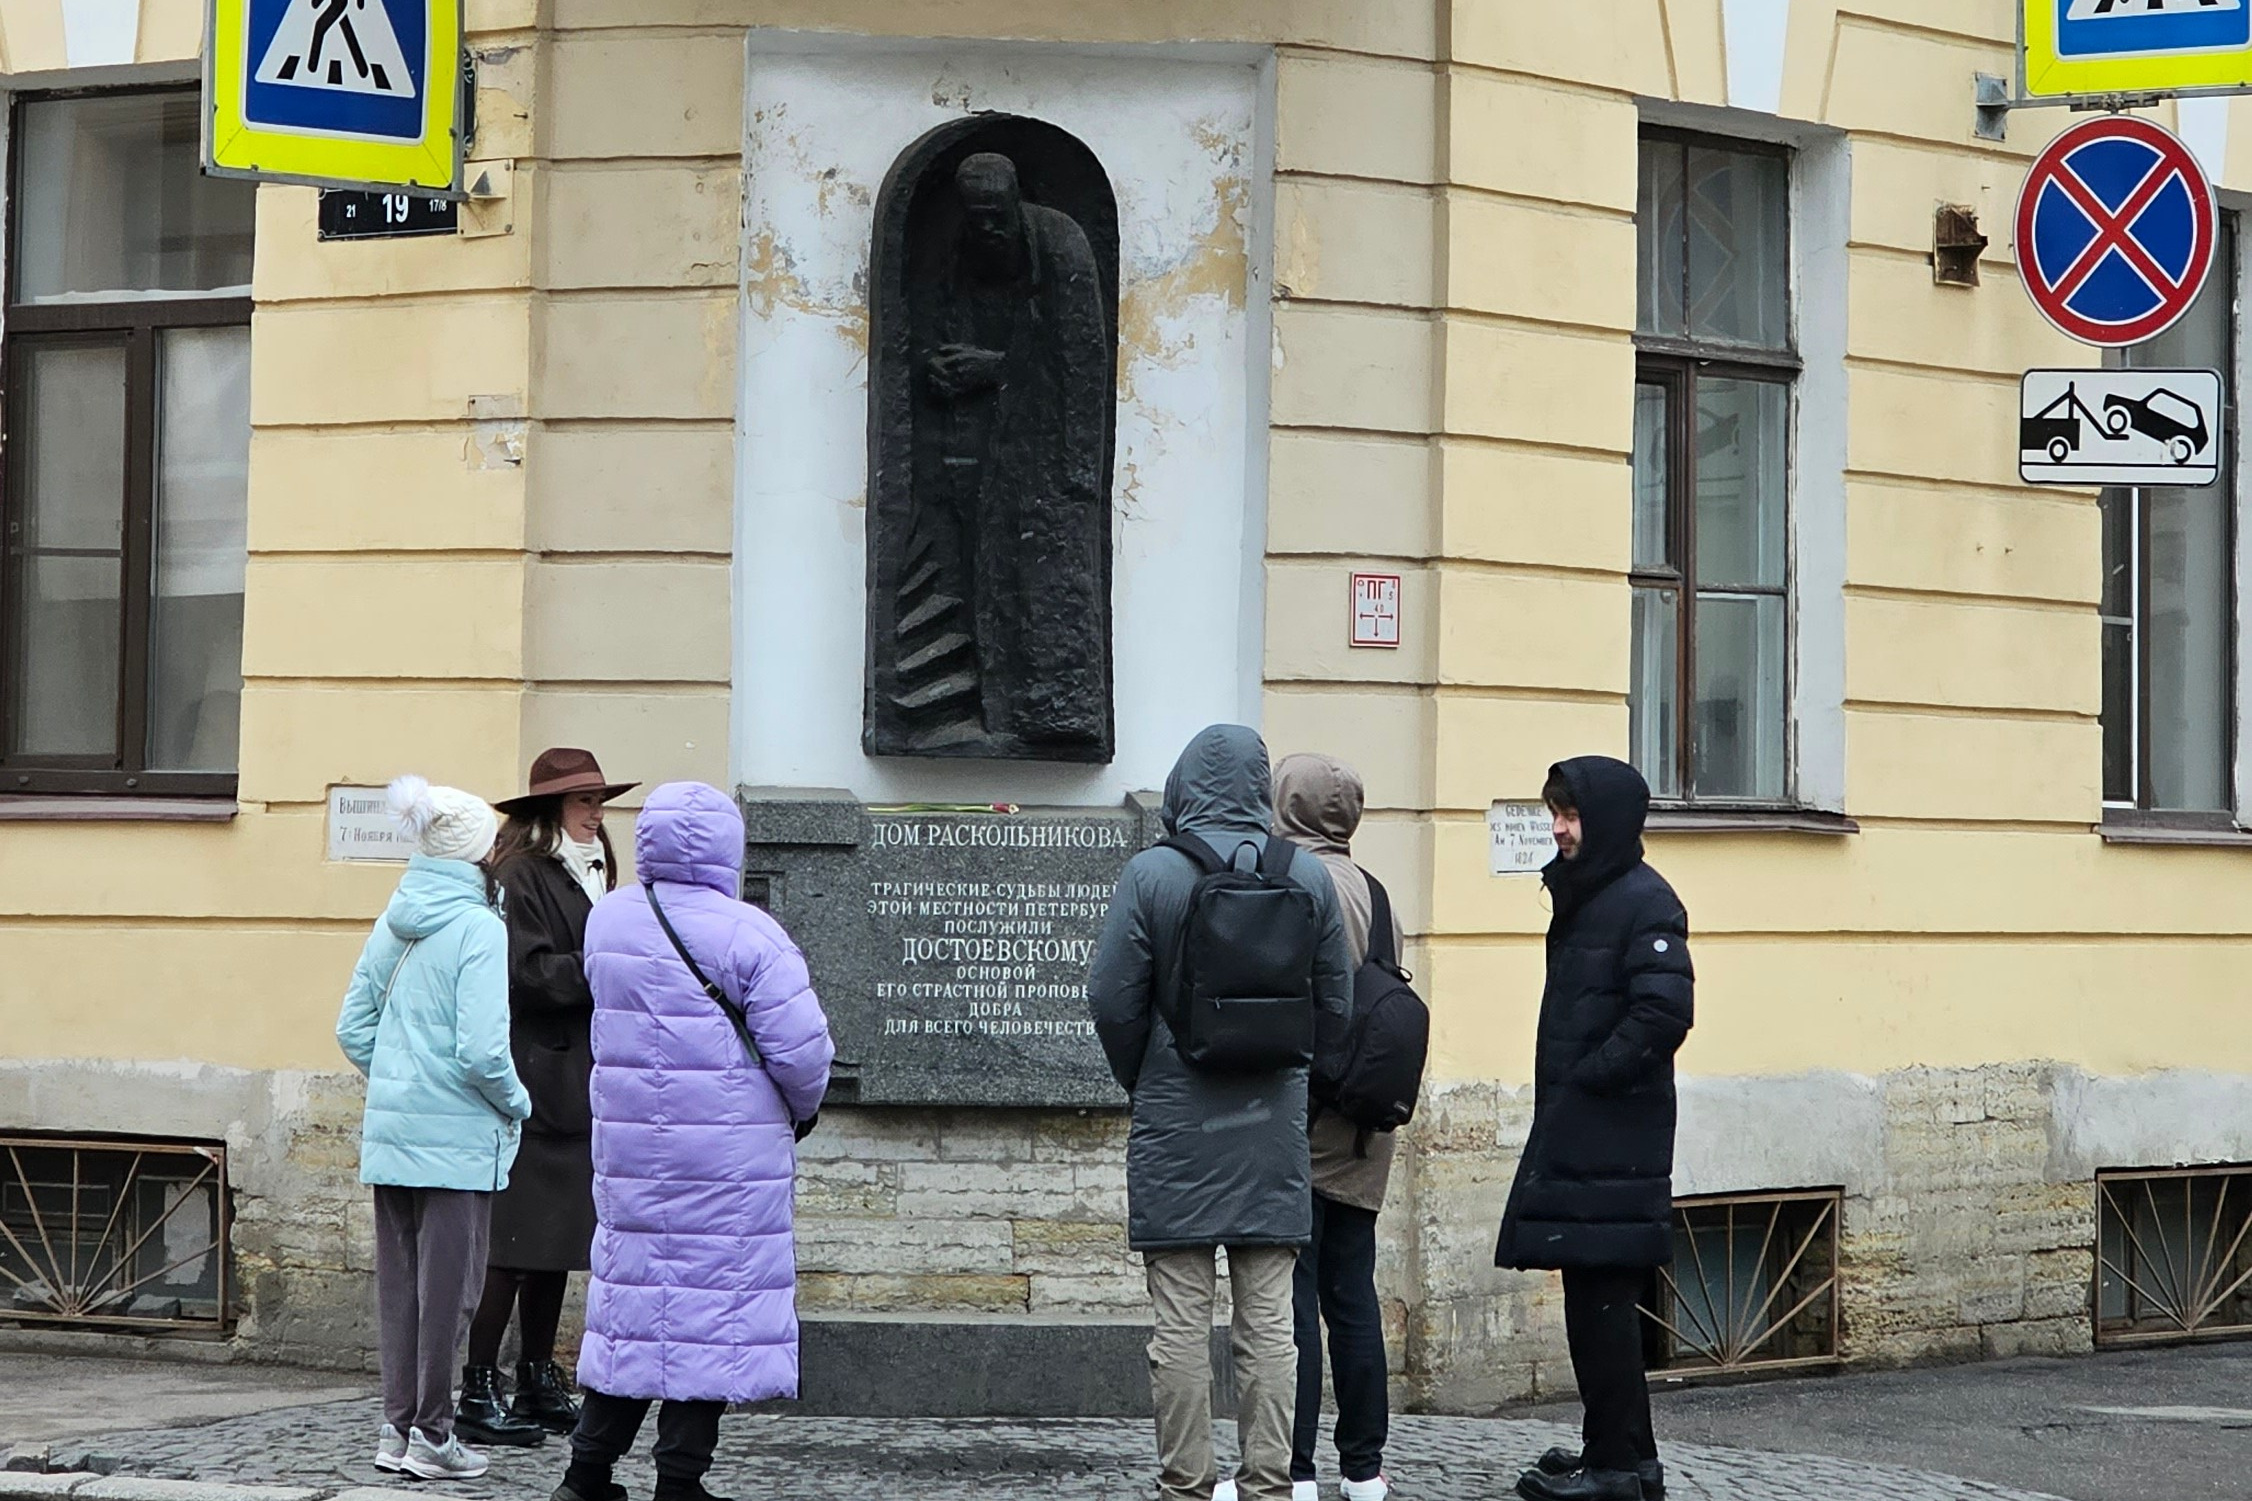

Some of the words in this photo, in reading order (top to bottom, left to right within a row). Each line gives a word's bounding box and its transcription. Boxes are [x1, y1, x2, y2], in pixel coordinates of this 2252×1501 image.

[346, 204, 356, 218] 21
[382, 193, 409, 223] 19
[1367, 580, 1386, 599] ПГ
[340, 826, 348, 842] 7
[871, 824, 920, 849] ДОМ
[928, 824, 1128, 848] РАСКОЛЬНИКОВА
[1510, 833, 1515, 847] 7
[871, 882, 990, 898] ТРАГИЧЕСКИЕ
[996, 883, 1061, 900] СУДЬБЫ
[867, 899, 913, 916] ЭТОЙ
[918, 901, 1019, 917] МЕСТНОСТИ
[1024, 902, 1109, 919] ПЕТЕРБУР
[944, 920, 1053, 935] ПОСЛУЖИЛИ
[902, 938, 1095, 966] ДОСТОЕВСКОМУ
[956, 964, 1036, 980] ОСНОВОЙ
[877, 983, 907, 997] ЕГО
[912, 982, 1009, 998] СТРАСТНОЙ
[1014, 984, 1088, 999] ПРОПОВЕ
[968, 1002, 1023, 1018] ДОБРА
[884, 1020, 918, 1036] ДЛЯ
[925, 1020, 973, 1035] ВСЕГО
[978, 1021, 1098, 1036] ЧЕЛОВЕЧЕСТВ
